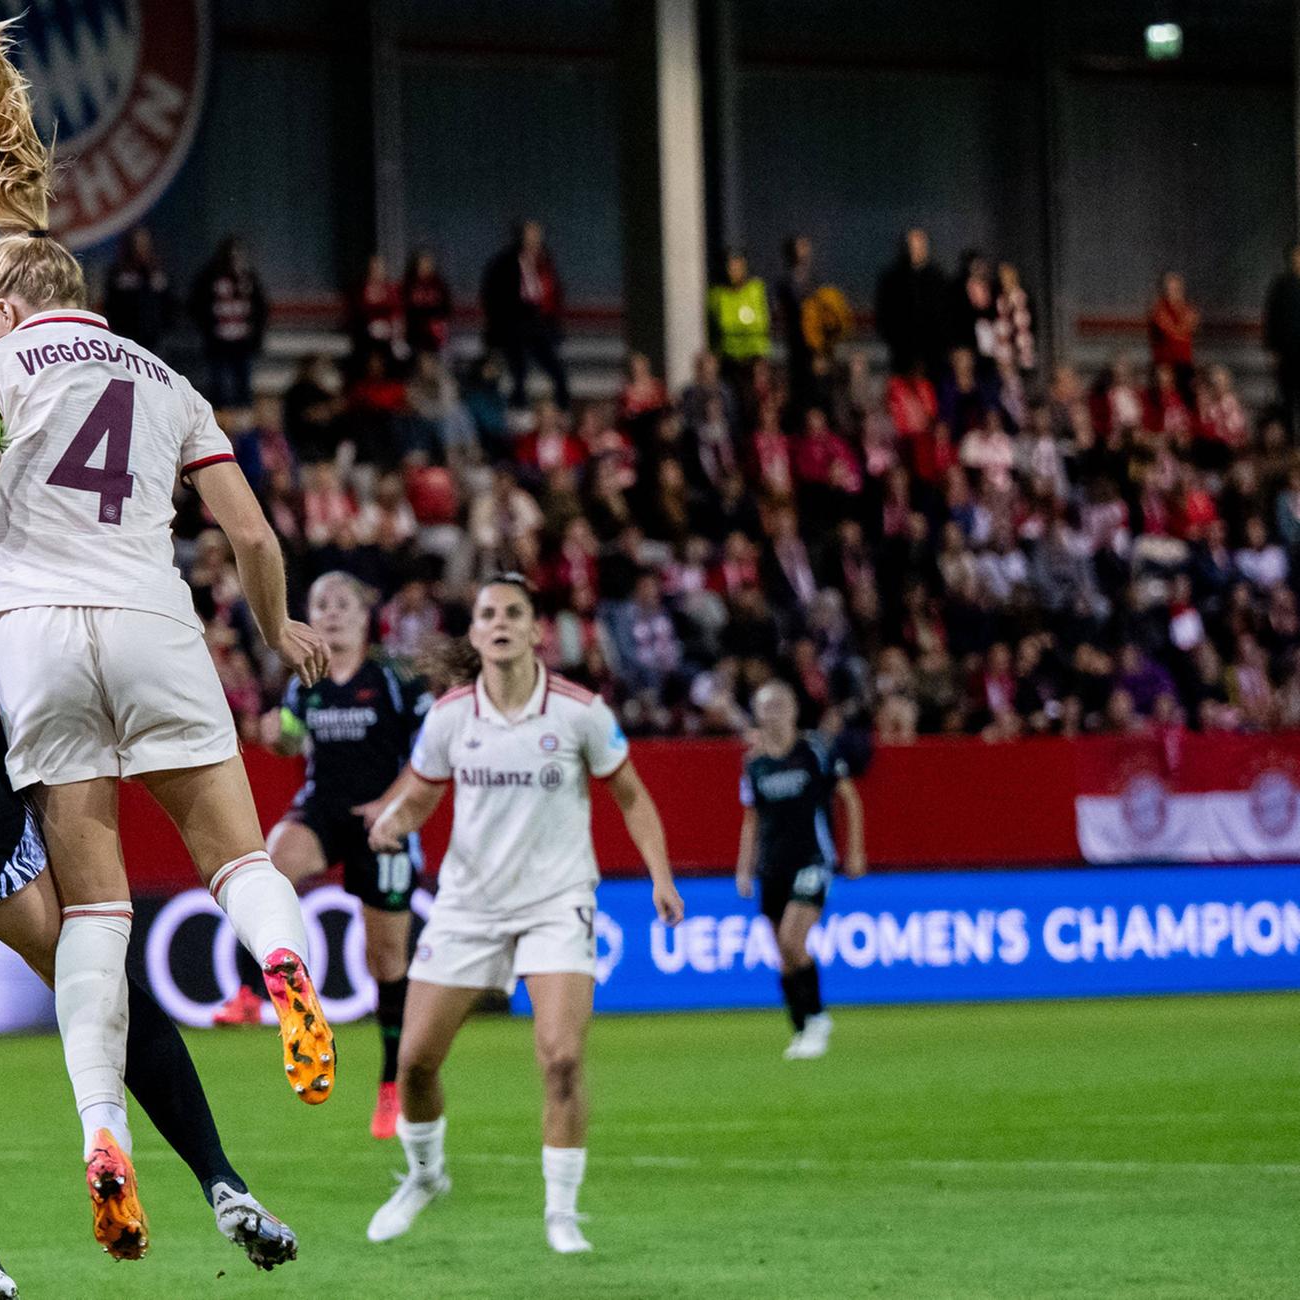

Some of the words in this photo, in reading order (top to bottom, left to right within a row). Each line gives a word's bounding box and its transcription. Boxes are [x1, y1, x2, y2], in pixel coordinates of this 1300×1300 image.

[45, 378, 135, 526] 4
[459, 765, 534, 788] Allianz
[376, 852, 412, 894] 10
[650, 914, 785, 974] UEFA
